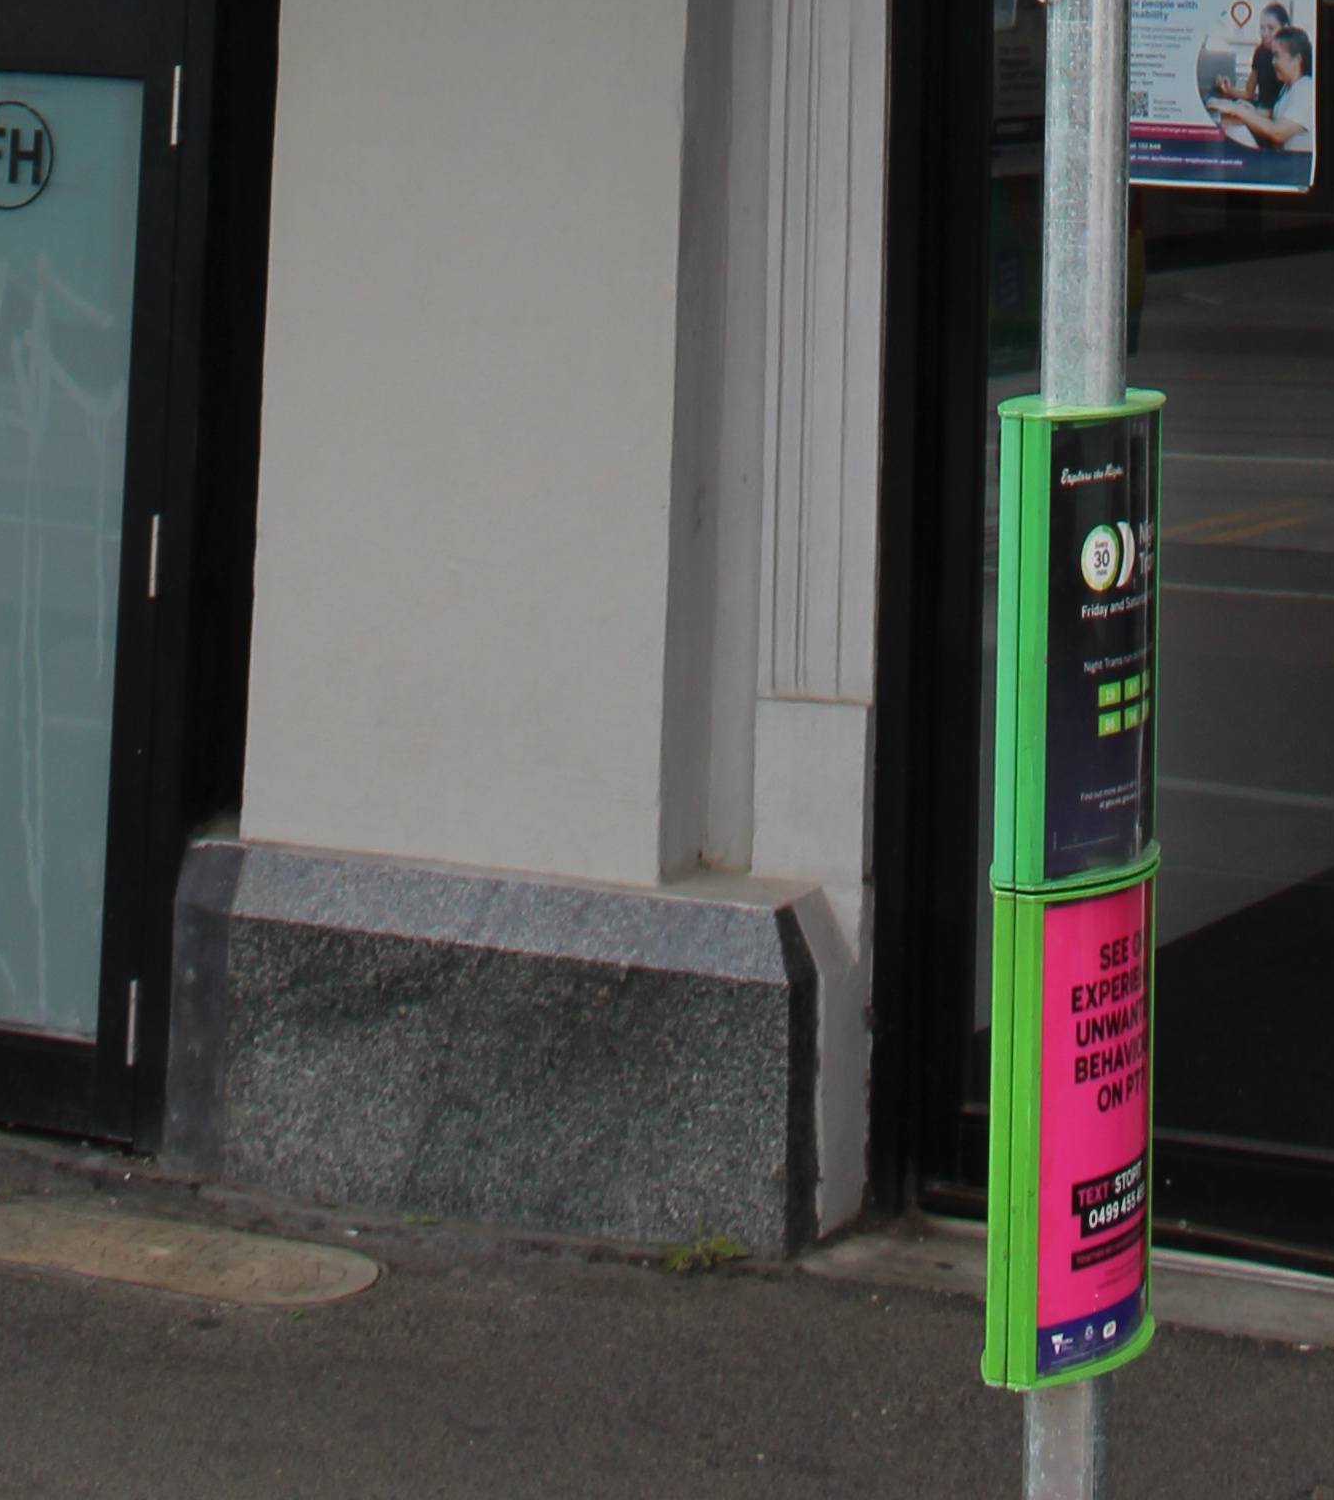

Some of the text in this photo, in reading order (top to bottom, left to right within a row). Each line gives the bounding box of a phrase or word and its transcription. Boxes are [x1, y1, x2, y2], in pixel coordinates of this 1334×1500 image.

[1093, 550, 1110, 569] 30
[1081, 603, 1108, 620] Friday
[1099, 935, 1129, 971] SEE
[1071, 968, 1143, 1014] EXPERIE
[1097, 1076, 1123, 1113] ON
[1077, 1181, 1110, 1208] TEXT
[1088, 1201, 1120, 1229] 0499
[1120, 1192, 1136, 1215] 455
